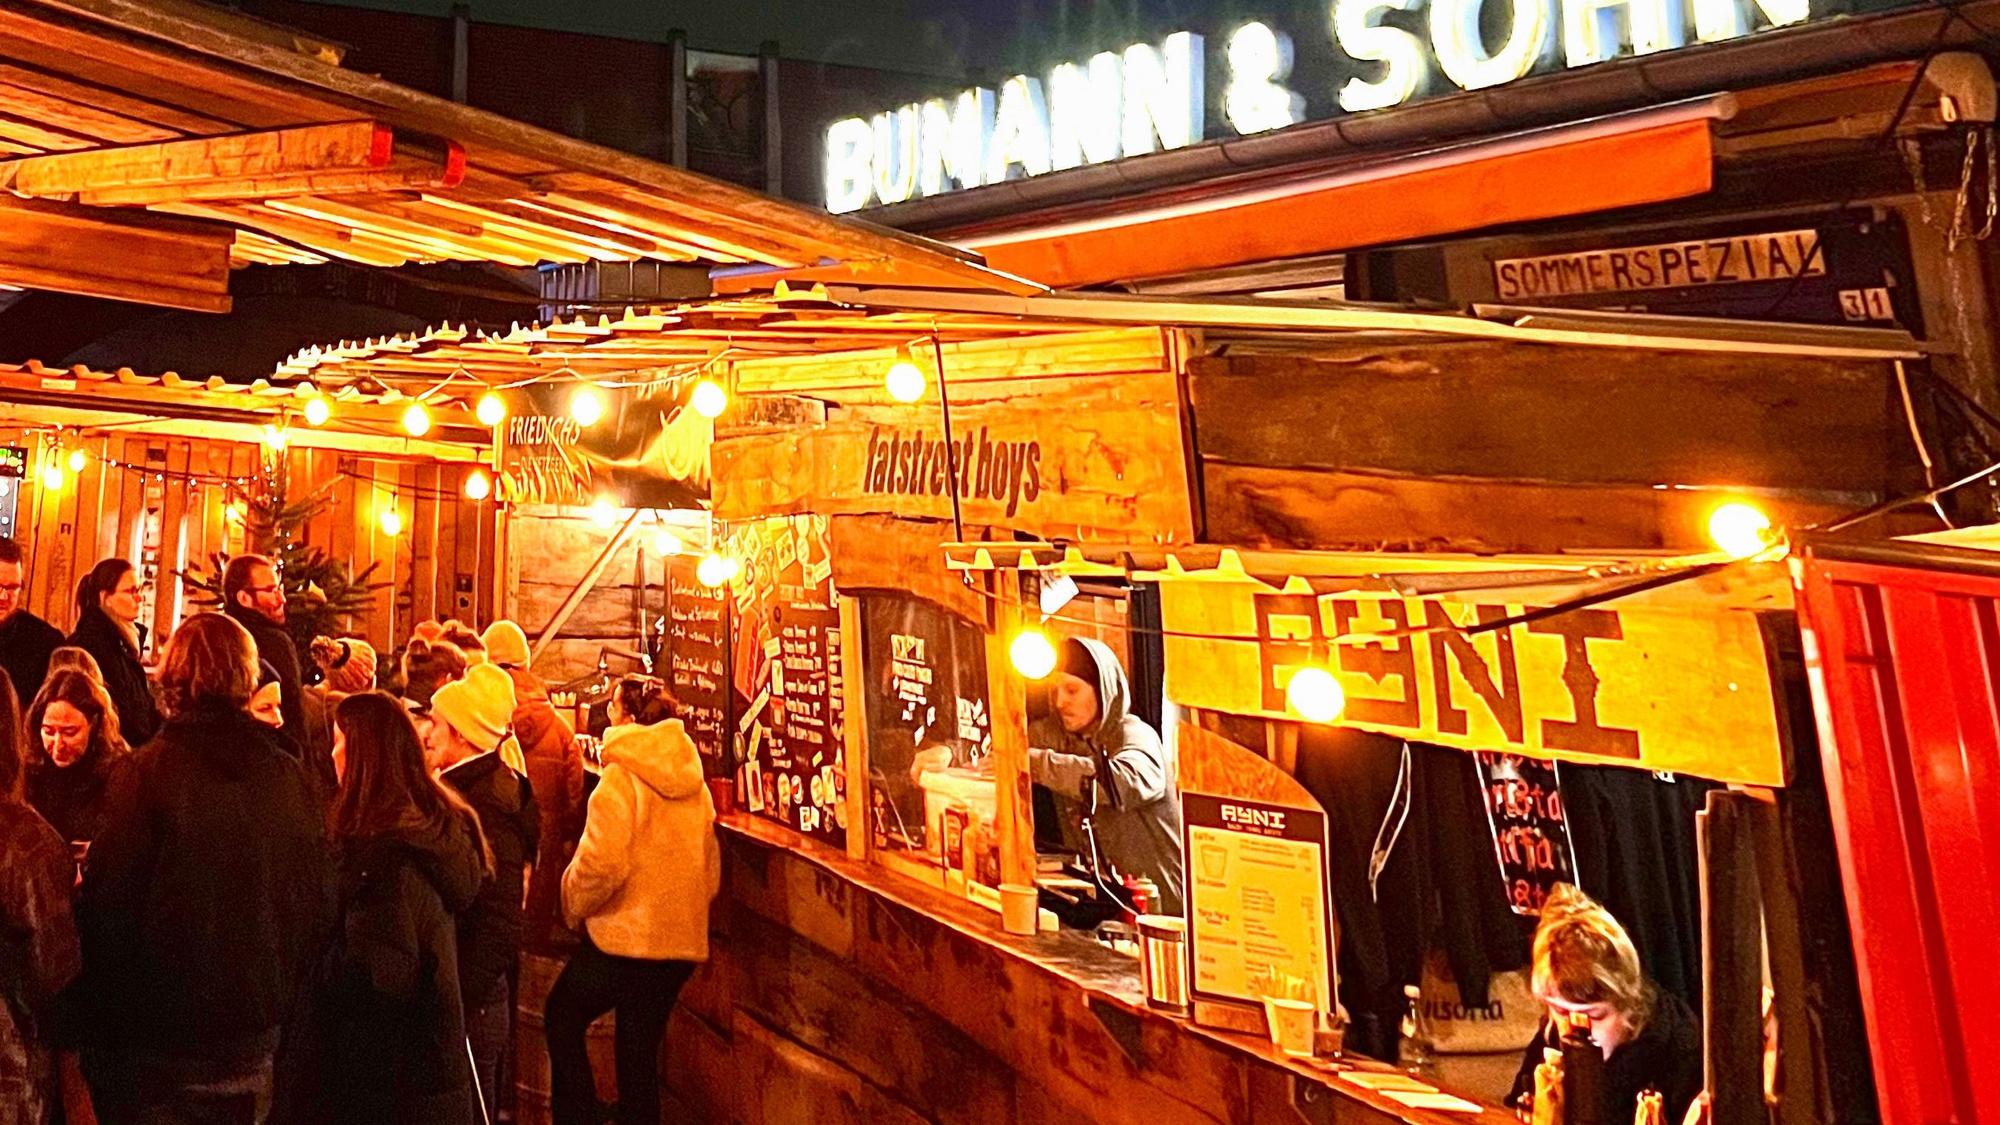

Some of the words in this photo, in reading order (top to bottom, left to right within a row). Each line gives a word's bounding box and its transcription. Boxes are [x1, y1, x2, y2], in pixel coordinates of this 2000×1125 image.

[826, 30, 1203, 215] BUMANN
[1227, 21, 1300, 135] &
[1500, 236, 1823, 299] SOMMERSPEZIAL
[863, 425, 974, 499] fatstreet
[974, 425, 1041, 519] boys
[1221, 804, 1286, 829] AYNI
